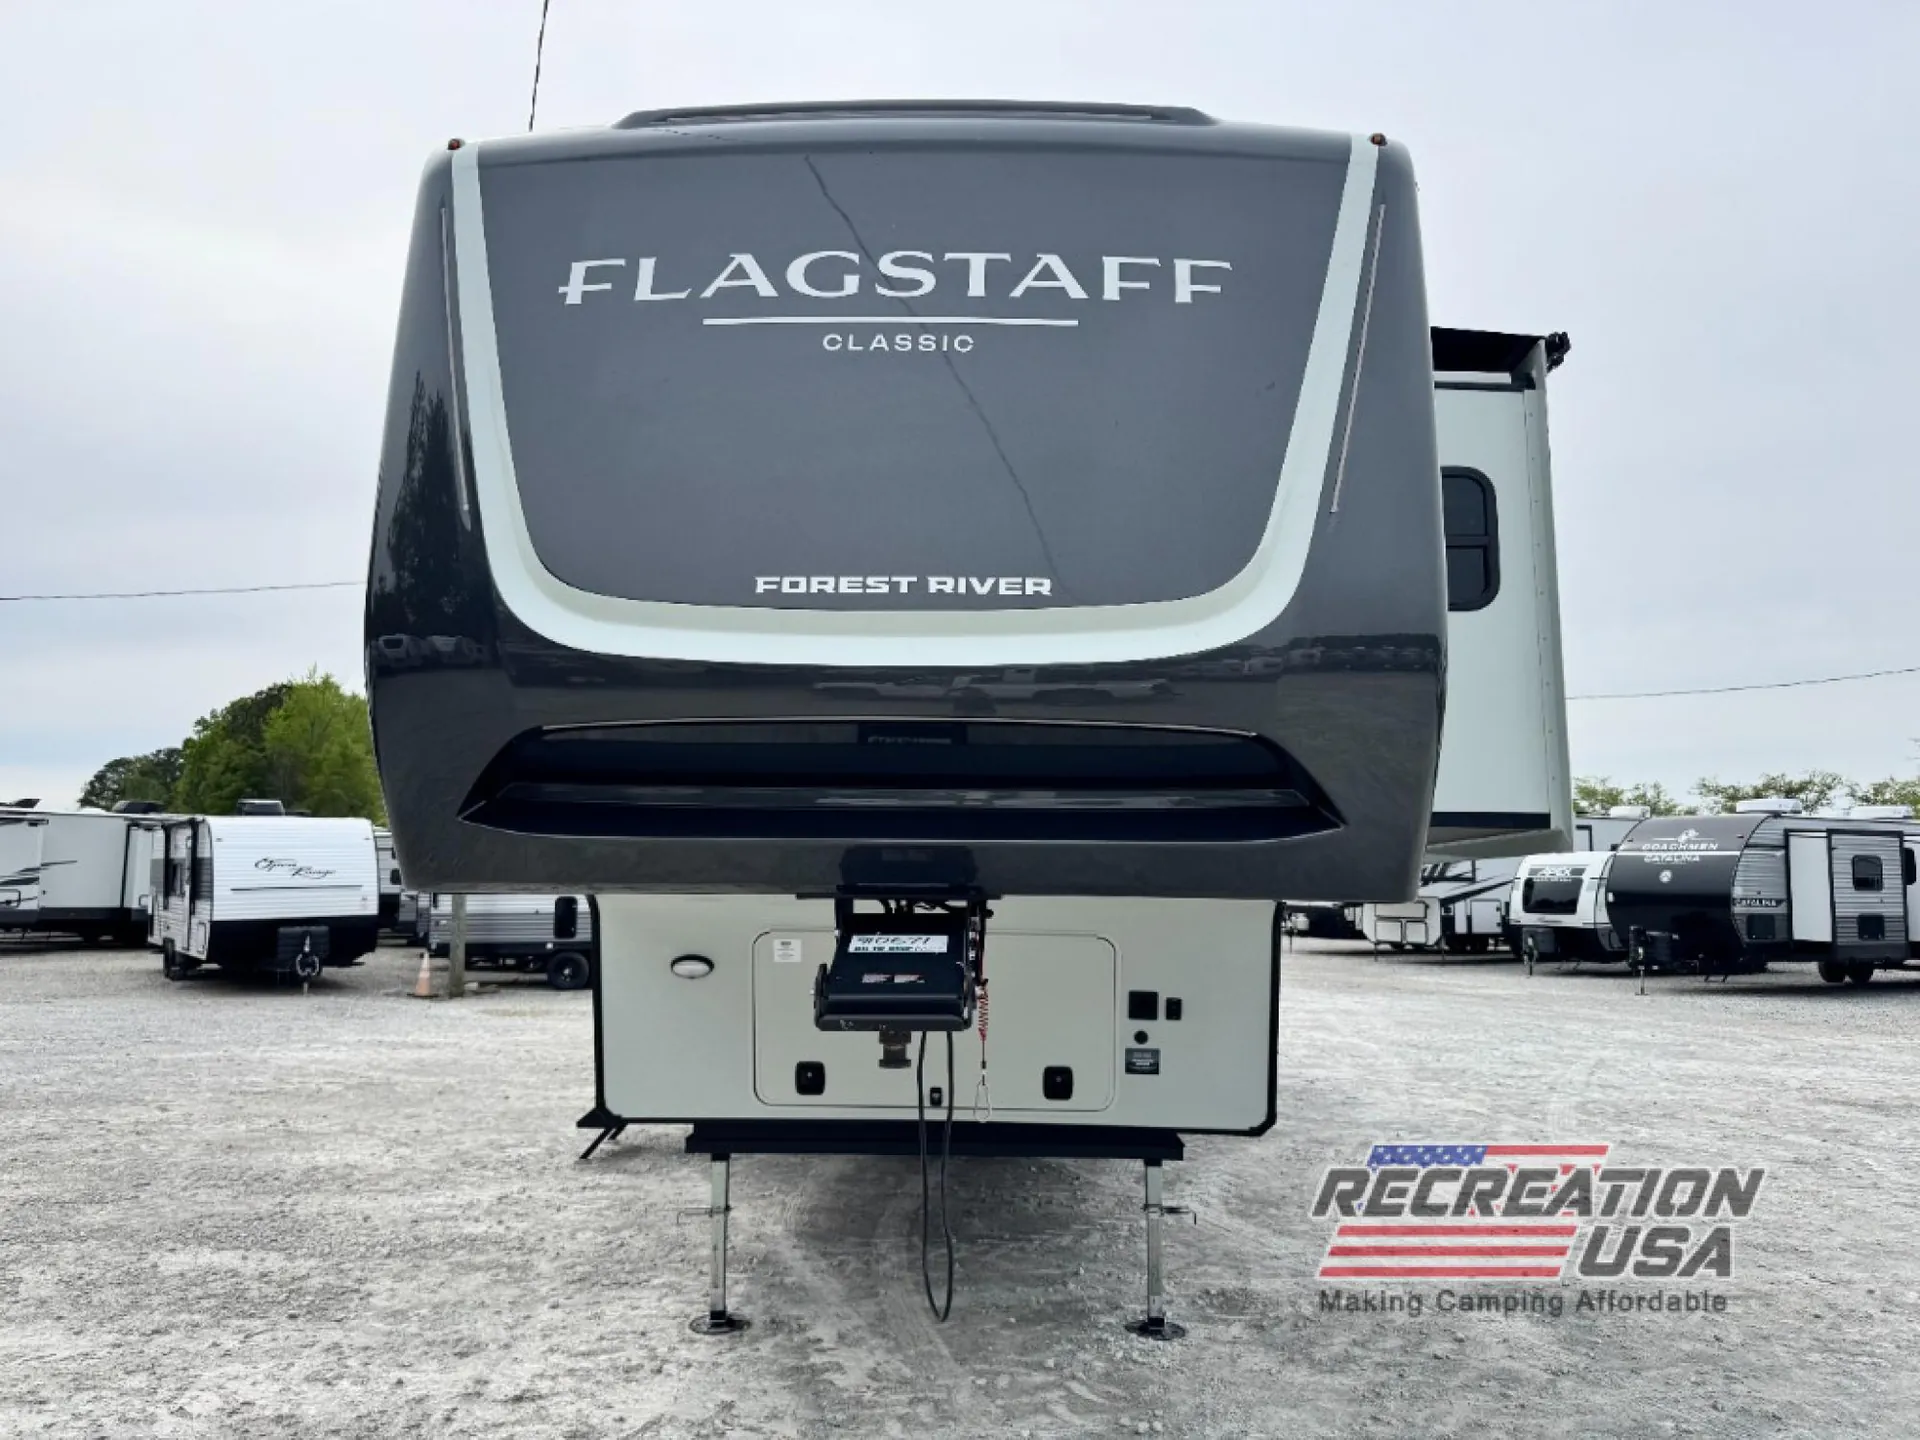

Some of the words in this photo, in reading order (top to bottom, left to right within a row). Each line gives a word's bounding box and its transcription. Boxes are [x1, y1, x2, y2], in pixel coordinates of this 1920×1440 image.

[557, 250, 1232, 306] FLAGSTAFF
[822, 332, 975, 354] CLASSIC
[754, 575, 918, 595] FOREST
[926, 575, 1053, 597] RIVER
